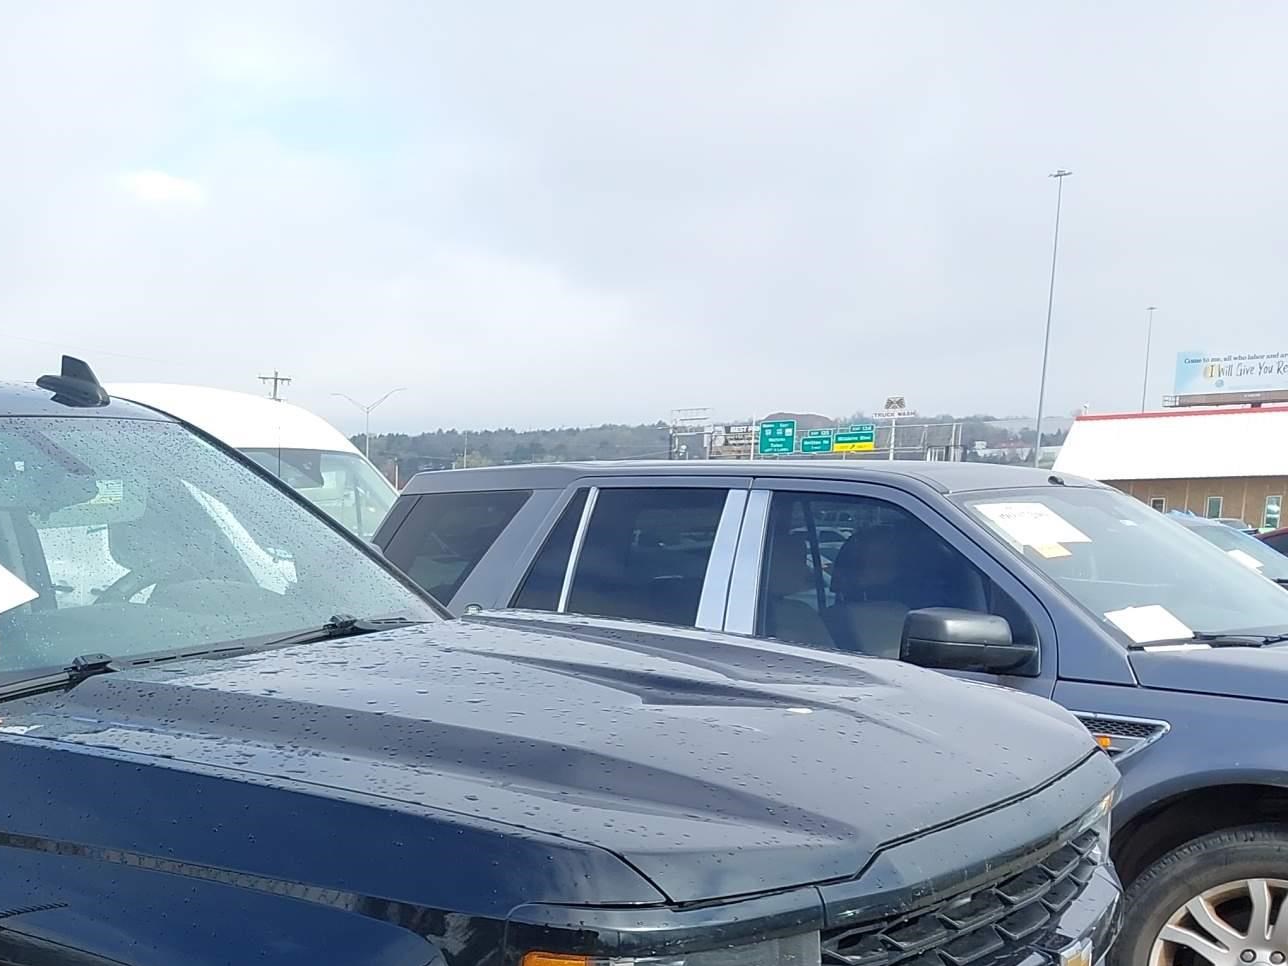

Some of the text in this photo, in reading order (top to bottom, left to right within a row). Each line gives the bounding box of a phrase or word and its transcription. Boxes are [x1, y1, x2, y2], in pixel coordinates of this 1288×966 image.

[1208, 364, 1215, 378] I
[1218, 363, 1233, 377] Will
[1236, 362, 1255, 377] Give
[1258, 361, 1274, 376] You
